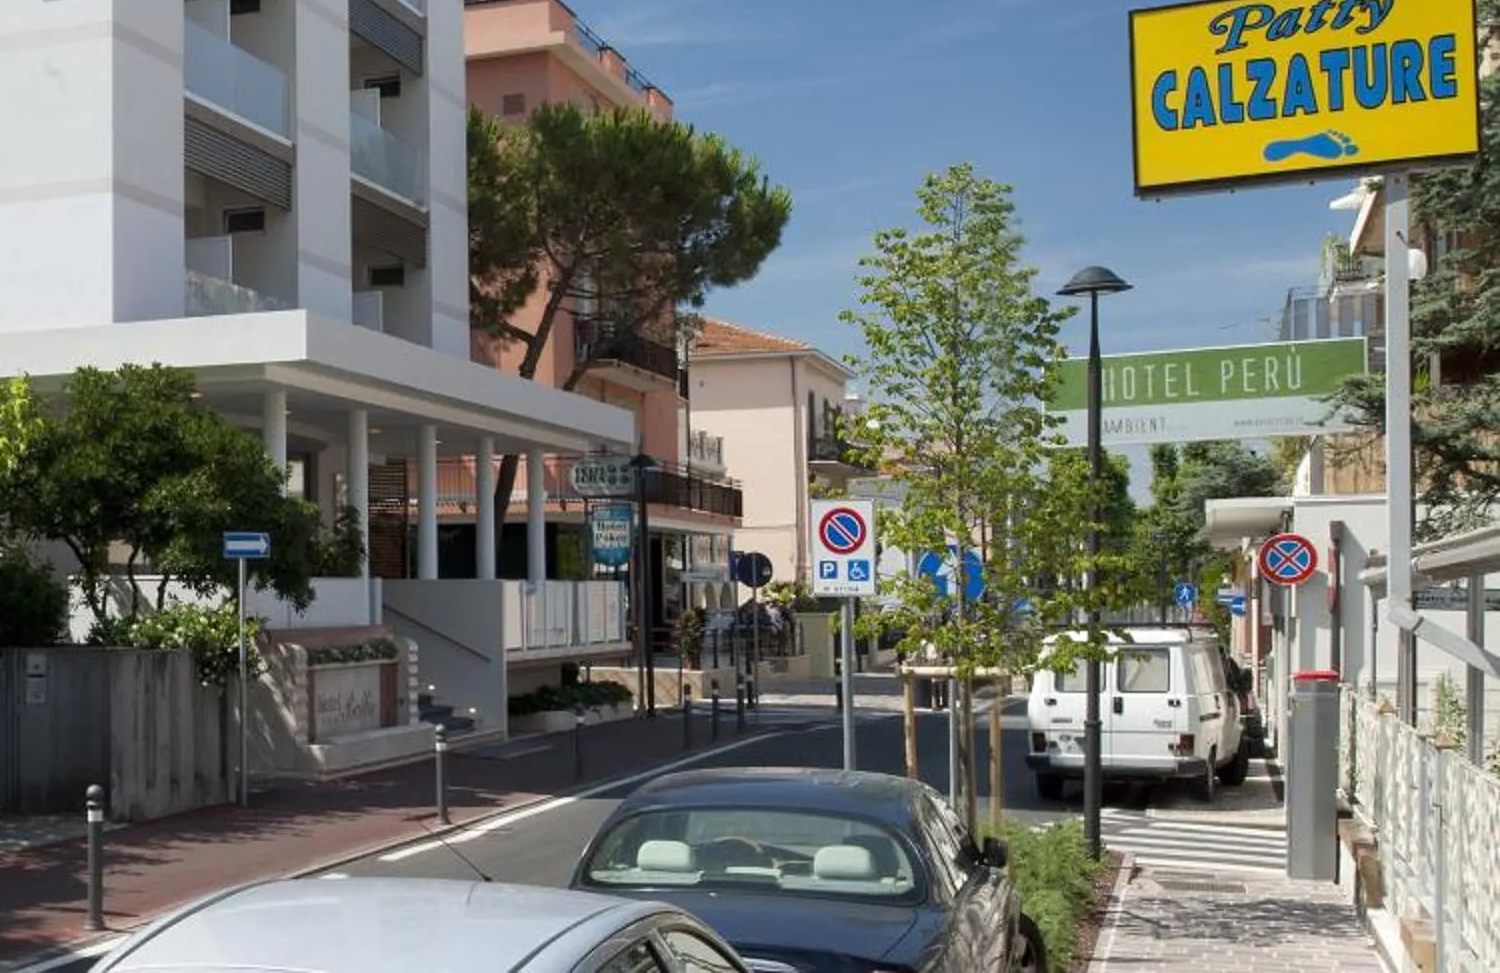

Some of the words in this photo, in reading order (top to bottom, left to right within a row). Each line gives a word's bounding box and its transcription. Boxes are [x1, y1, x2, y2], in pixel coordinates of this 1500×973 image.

[1151, 32, 1458, 131] CALZATURE
[1101, 362, 1200, 402] HOTEL
[823, 563, 835, 578] P
